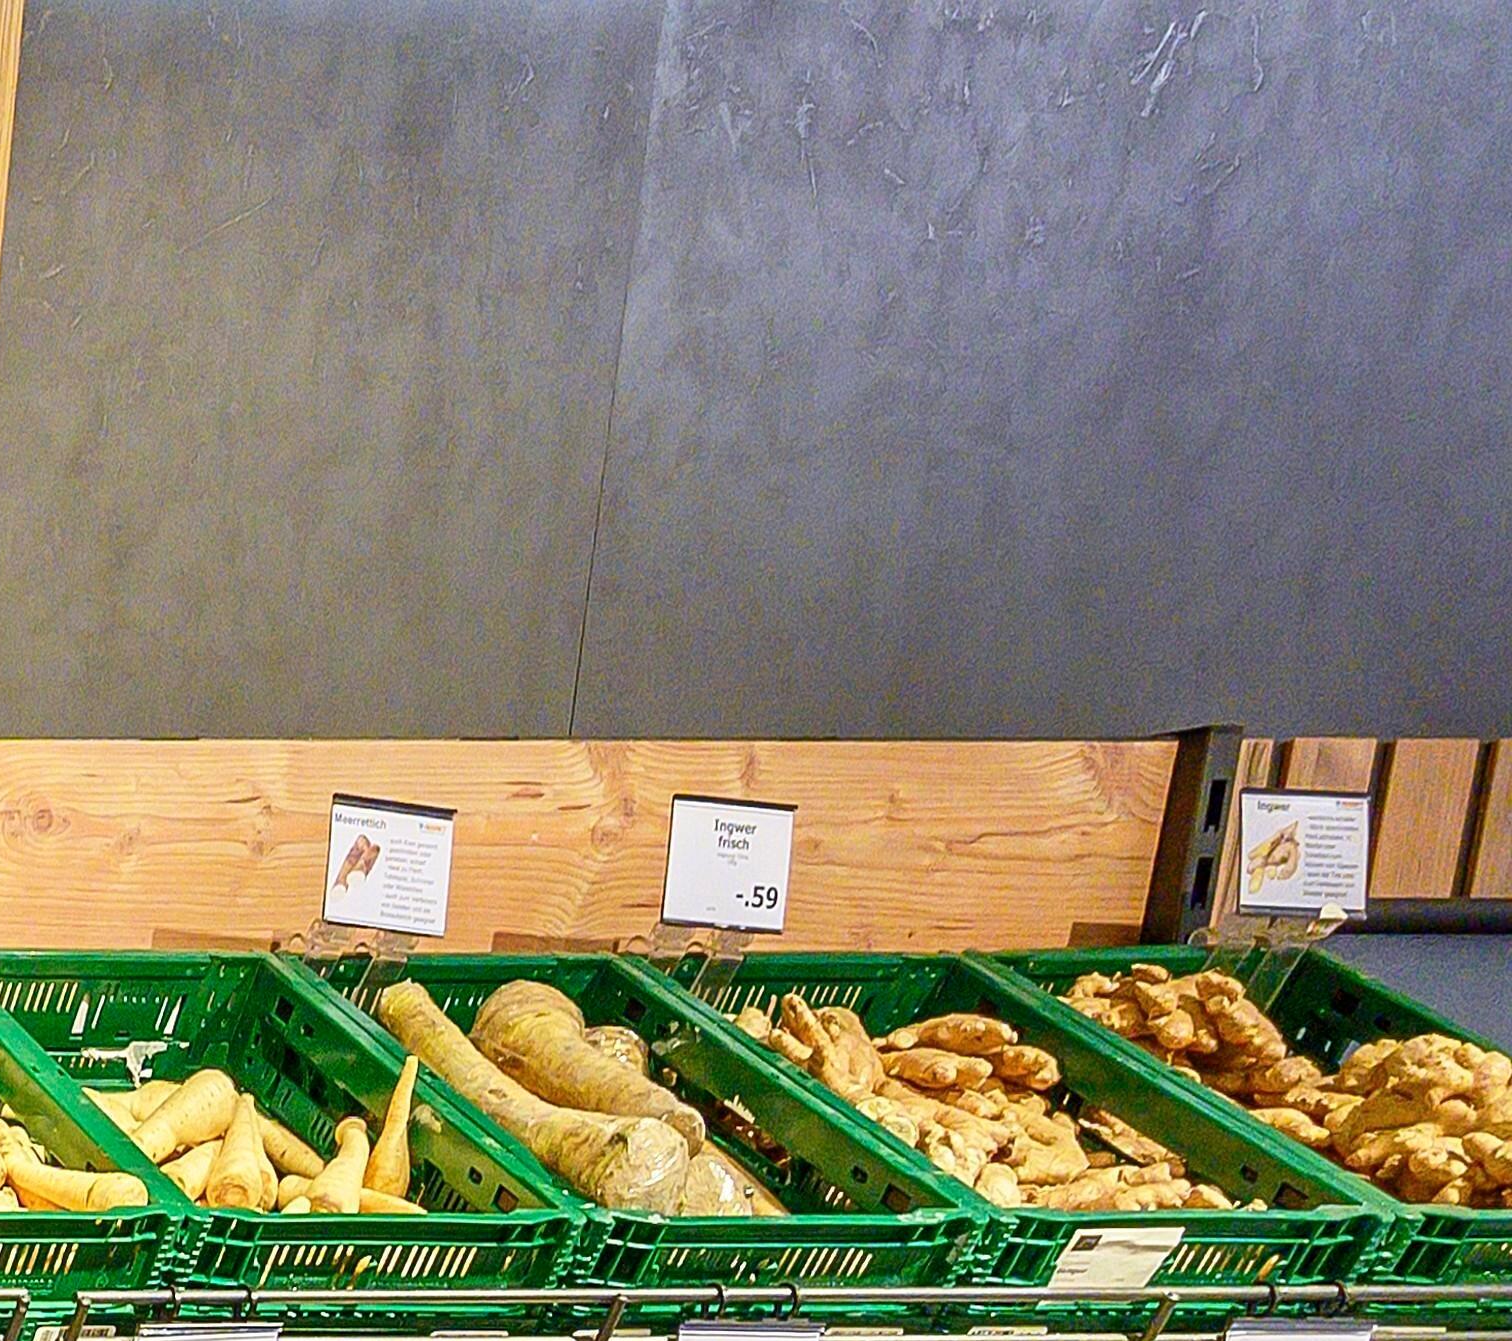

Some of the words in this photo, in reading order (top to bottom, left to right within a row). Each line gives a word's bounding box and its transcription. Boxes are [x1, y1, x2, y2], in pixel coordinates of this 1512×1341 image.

[1257, 799, 1291, 814] Ingwer
[334, 812, 386, 829] Meerrettich
[714, 818, 757, 840] Ingwer
[718, 835, 750, 851] frisch
[735, 885, 779, 910] -.59
